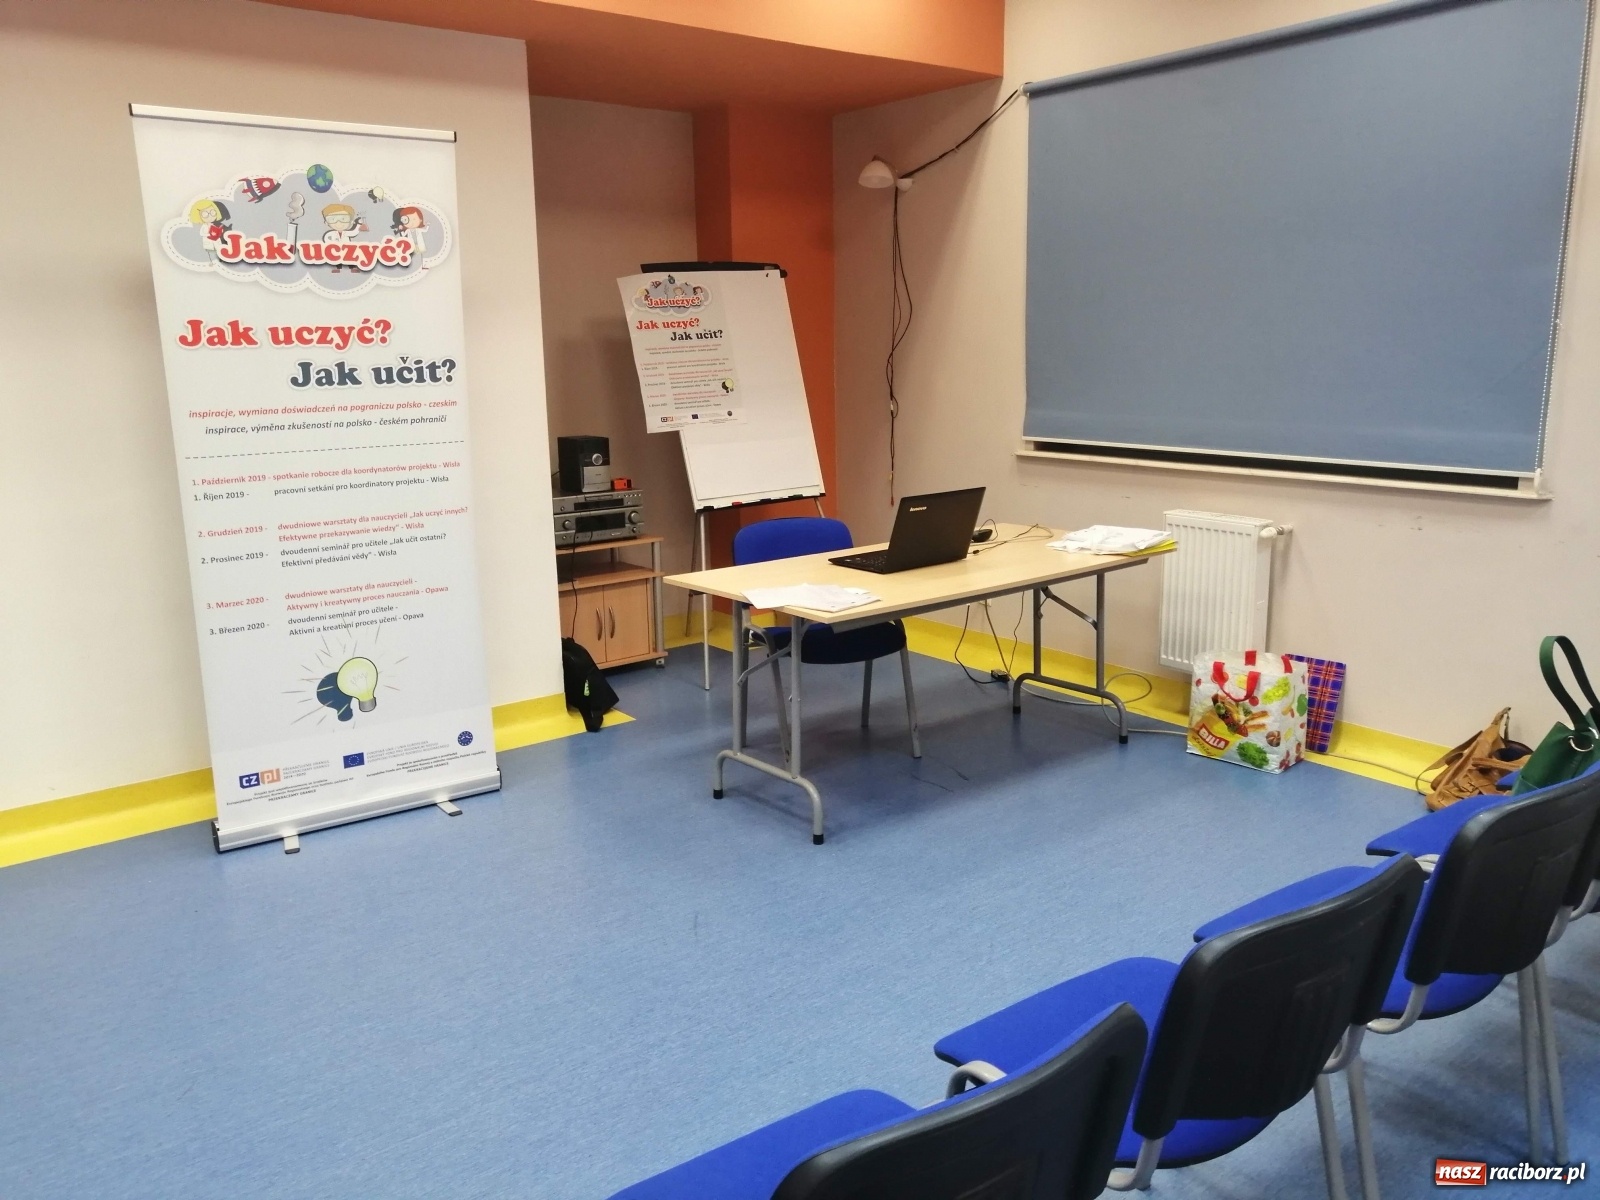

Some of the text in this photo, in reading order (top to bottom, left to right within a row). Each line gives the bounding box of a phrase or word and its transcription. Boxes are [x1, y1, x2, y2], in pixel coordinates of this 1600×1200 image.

[220, 234, 412, 267] Jak uczyć?
[648, 296, 701, 307] Jak uczyć?
[178, 317, 392, 350] Jak uczyć?
[636, 317, 700, 330] Jak uczyć?
[670, 331, 693, 341] Jak
[290, 356, 457, 388] Jak učit?
[188, 409, 236, 419] inspiracje,
[238, 407, 279, 418] wymiana
[281, 404, 336, 414] doświadczeń
[338, 404, 348, 412] na
[350, 402, 395, 412] pograniczu
[396, 401, 422, 410] polsko
[428, 400, 457, 408] czeskim
[205, 426, 248, 435] inspirace,
[251, 424, 285, 433] výměna
[346, 419, 372, 428] polsko
[379, 416, 408, 425] českém
[202, 476, 246, 486] Październik
[248, 474, 266, 482] 2019
[273, 472, 309, 481] spotkanie
[341, 468, 352, 476] dla
[354, 464, 406, 475] koordynatorów
[408, 463, 437, 472] projektu
[203, 492, 224, 501] Říjen
[226, 491, 245, 499] 2019
[349, 480, 394, 489] koordinatory
[396, 478, 425, 487] projektu
[207, 528, 242, 537] Grudzień
[278, 521, 321, 530] dwudniowe
[323, 518, 357, 527] warsztaty
[371, 512, 408, 522] nauczycieli
[426, 509, 443, 518] uczyć
[444, 507, 468, 515] innych?
[279, 532, 317, 542] Efektywne
[319, 528, 370, 540] przekazywanie
[210, 555, 244, 564] Prosinec
[246, 552, 264, 560] 2019
[322, 542, 350, 552] seminář
[352, 542, 363, 550] pro
[365, 539, 388, 548] učitele
[406, 535, 418, 543] učit
[216, 601, 244, 609] Marzec
[246, 597, 264, 605] 2020
[285, 590, 328, 600] dwudniowe
[330, 586, 363, 595] warsztaty
[377, 579, 413, 588] nauczycieli
[286, 601, 318, 611] Aktywny
[324, 597, 361, 606] kreatywny
[363, 594, 385, 602] proces
[386, 589, 419, 598] nauczania
[426, 586, 449, 594] Opawa
[219, 625, 245, 634] Březen
[247, 622, 265, 630] 2020
[328, 610, 356, 620] seminář
[358, 609, 369, 617] pro
[372, 605, 393, 614] učitele
[355, 620, 378, 628] proces
[403, 613, 424, 621] Opava
[1198, 726, 1226, 749] BILLA
